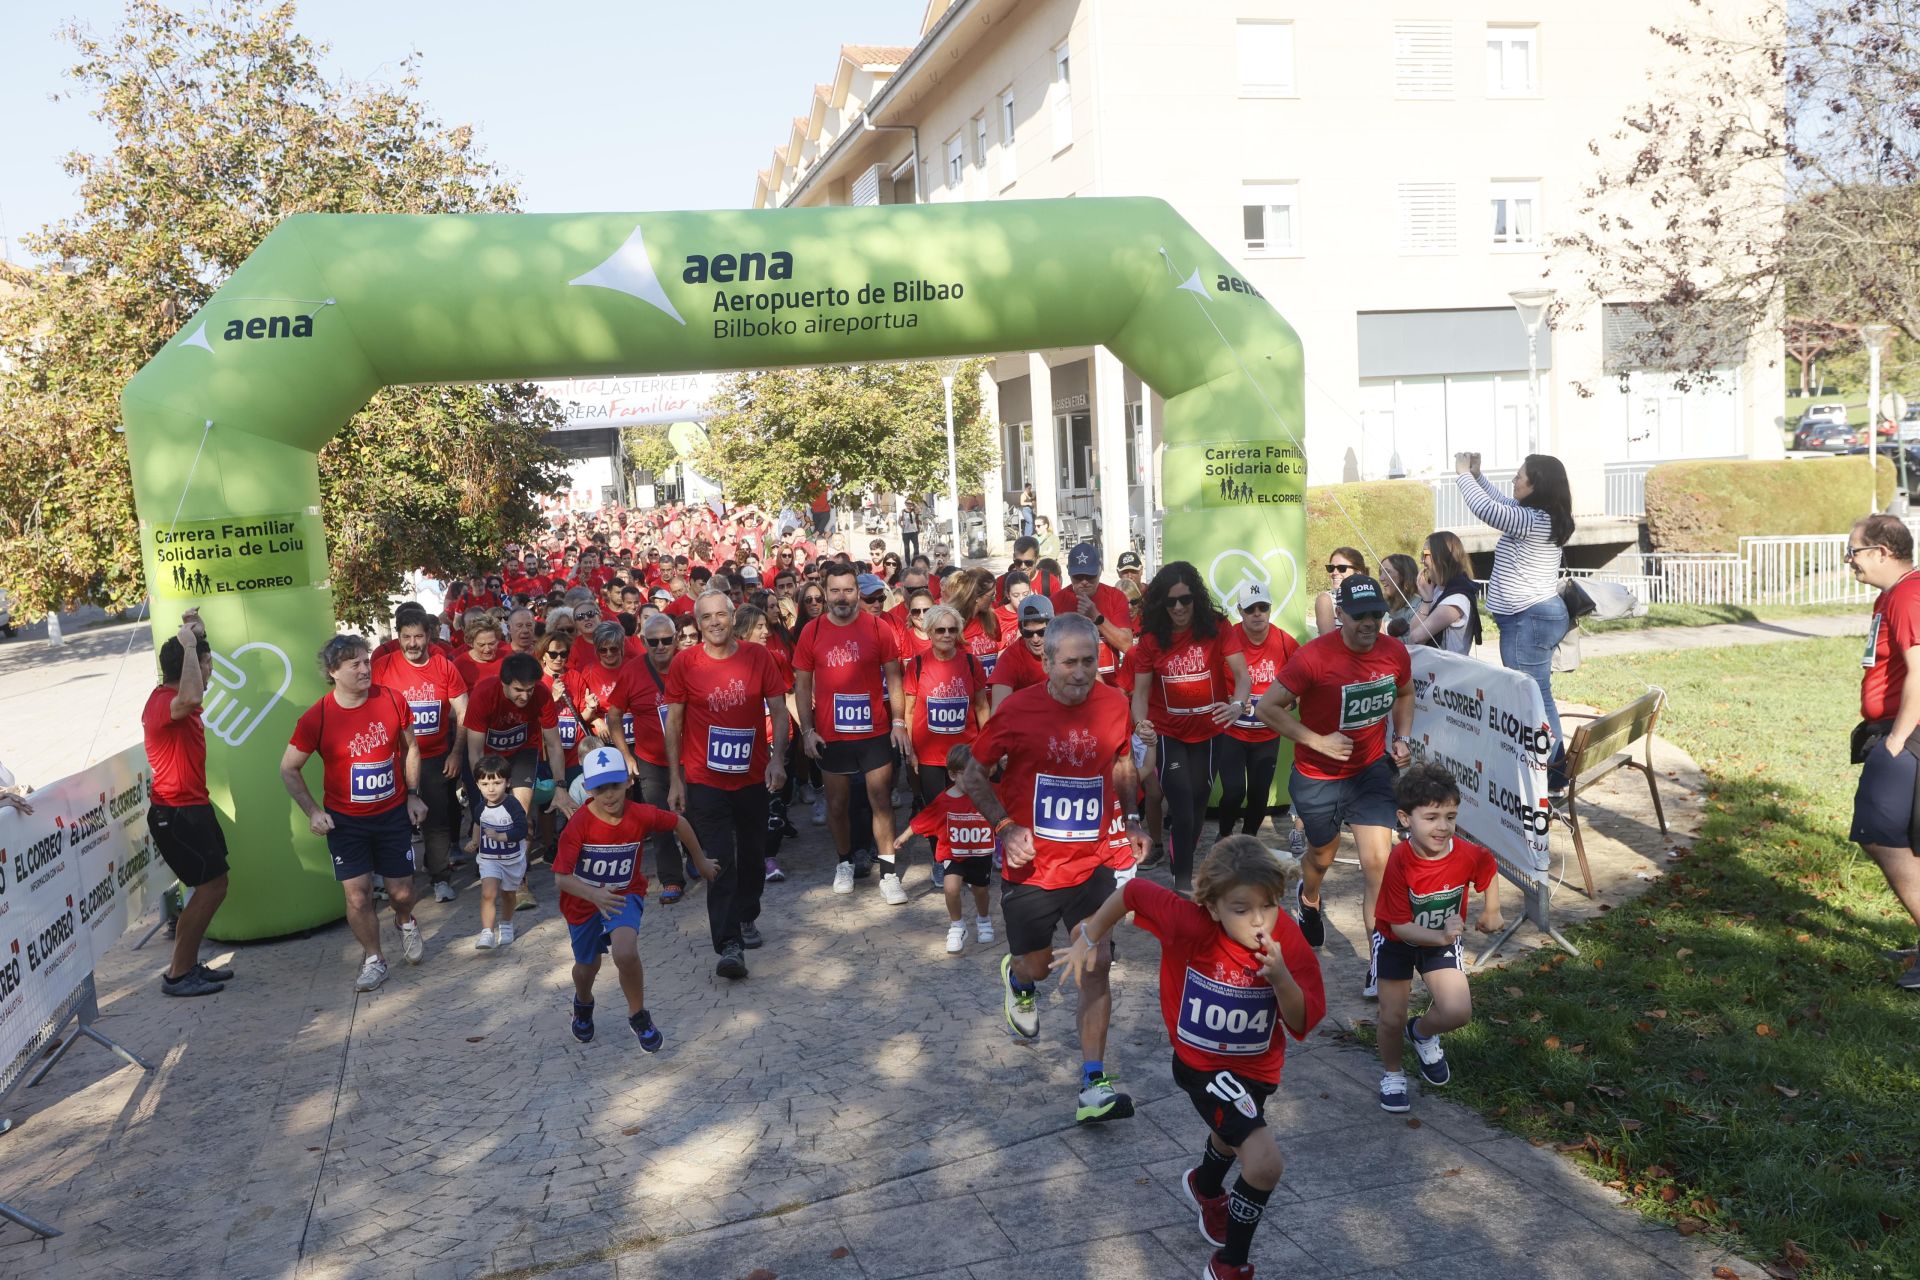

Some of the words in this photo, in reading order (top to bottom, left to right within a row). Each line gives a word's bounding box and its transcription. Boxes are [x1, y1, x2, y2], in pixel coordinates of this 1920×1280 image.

[682, 251, 793, 284] aena
[713, 287, 850, 314] Aeropuerto
[857, 283, 885, 304] de
[893, 280, 964, 303] Bilbao
[223, 313, 314, 341] aena
[714, 317, 797, 339] Bilboko
[804, 312, 918, 335] aireportua
[600, 377, 698, 396] LASTERKETA
[608, 394, 690, 420] Familiar
[1205, 448, 1261, 461] Carrera
[1205, 462, 1272, 476] Solidaria
[1275, 462, 1290, 474] de
[1257, 495, 1271, 503] EL
[1271, 494, 1303, 503] CORREO
[155, 528, 215, 544] Carrera
[221, 520, 295, 540] Familiar
[158, 544, 232, 562] Solidaria
[238, 543, 263, 557] de
[269, 538, 304, 553] Loiu
[216, 582, 235, 592] EL
[236, 575, 293, 591] CORREO
[1351, 584, 1375, 594] BORA
[837, 705, 871, 720] 1019
[929, 708, 965, 722] 1004
[1348, 691, 1393, 716] 2055
[1433, 685, 1446, 708] EL
[1444, 688, 1483, 722] CORREO
[412, 711, 437, 724] 003
[1489, 705, 1500, 732] EL
[491, 732, 524, 746] 1019
[711, 741, 751, 759] 1019
[355, 769, 394, 790] 1003
[1488, 780, 1500, 808] EL
[1041, 795, 1099, 821] 1019
[78, 804, 108, 840] CORREO
[949, 826, 992, 843] 3002
[15, 853, 28, 883] EL
[27, 830, 62, 874] CORREO
[582, 858, 632, 876] 1018
[79, 898, 90, 924] EL
[89, 875, 115, 915] CORREO
[27, 941, 41, 972] EL
[40, 910, 74, 960] CORREO
[1188, 997, 1268, 1034] 1004
[1206, 1070, 1247, 1102] 10
